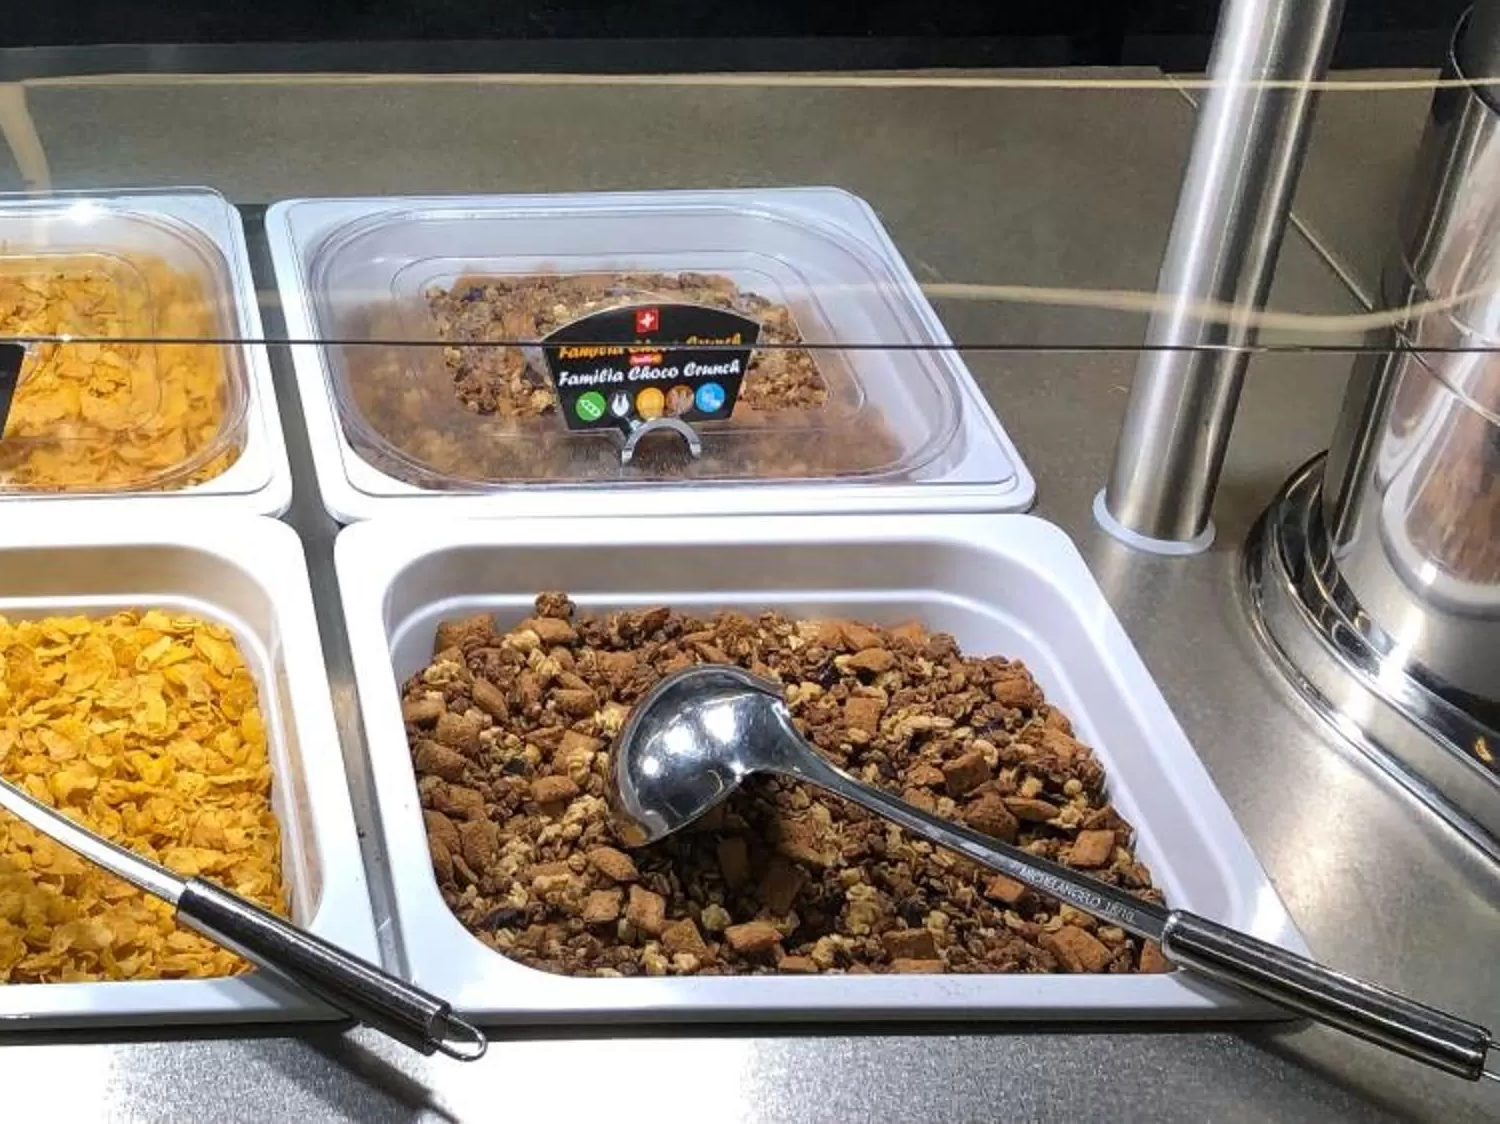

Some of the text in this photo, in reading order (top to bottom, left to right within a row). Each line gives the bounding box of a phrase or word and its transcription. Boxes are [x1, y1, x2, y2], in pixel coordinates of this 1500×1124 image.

[558, 366, 624, 387] Familia
[627, 361, 679, 382] Choco
[683, 358, 741, 377] Crunch
